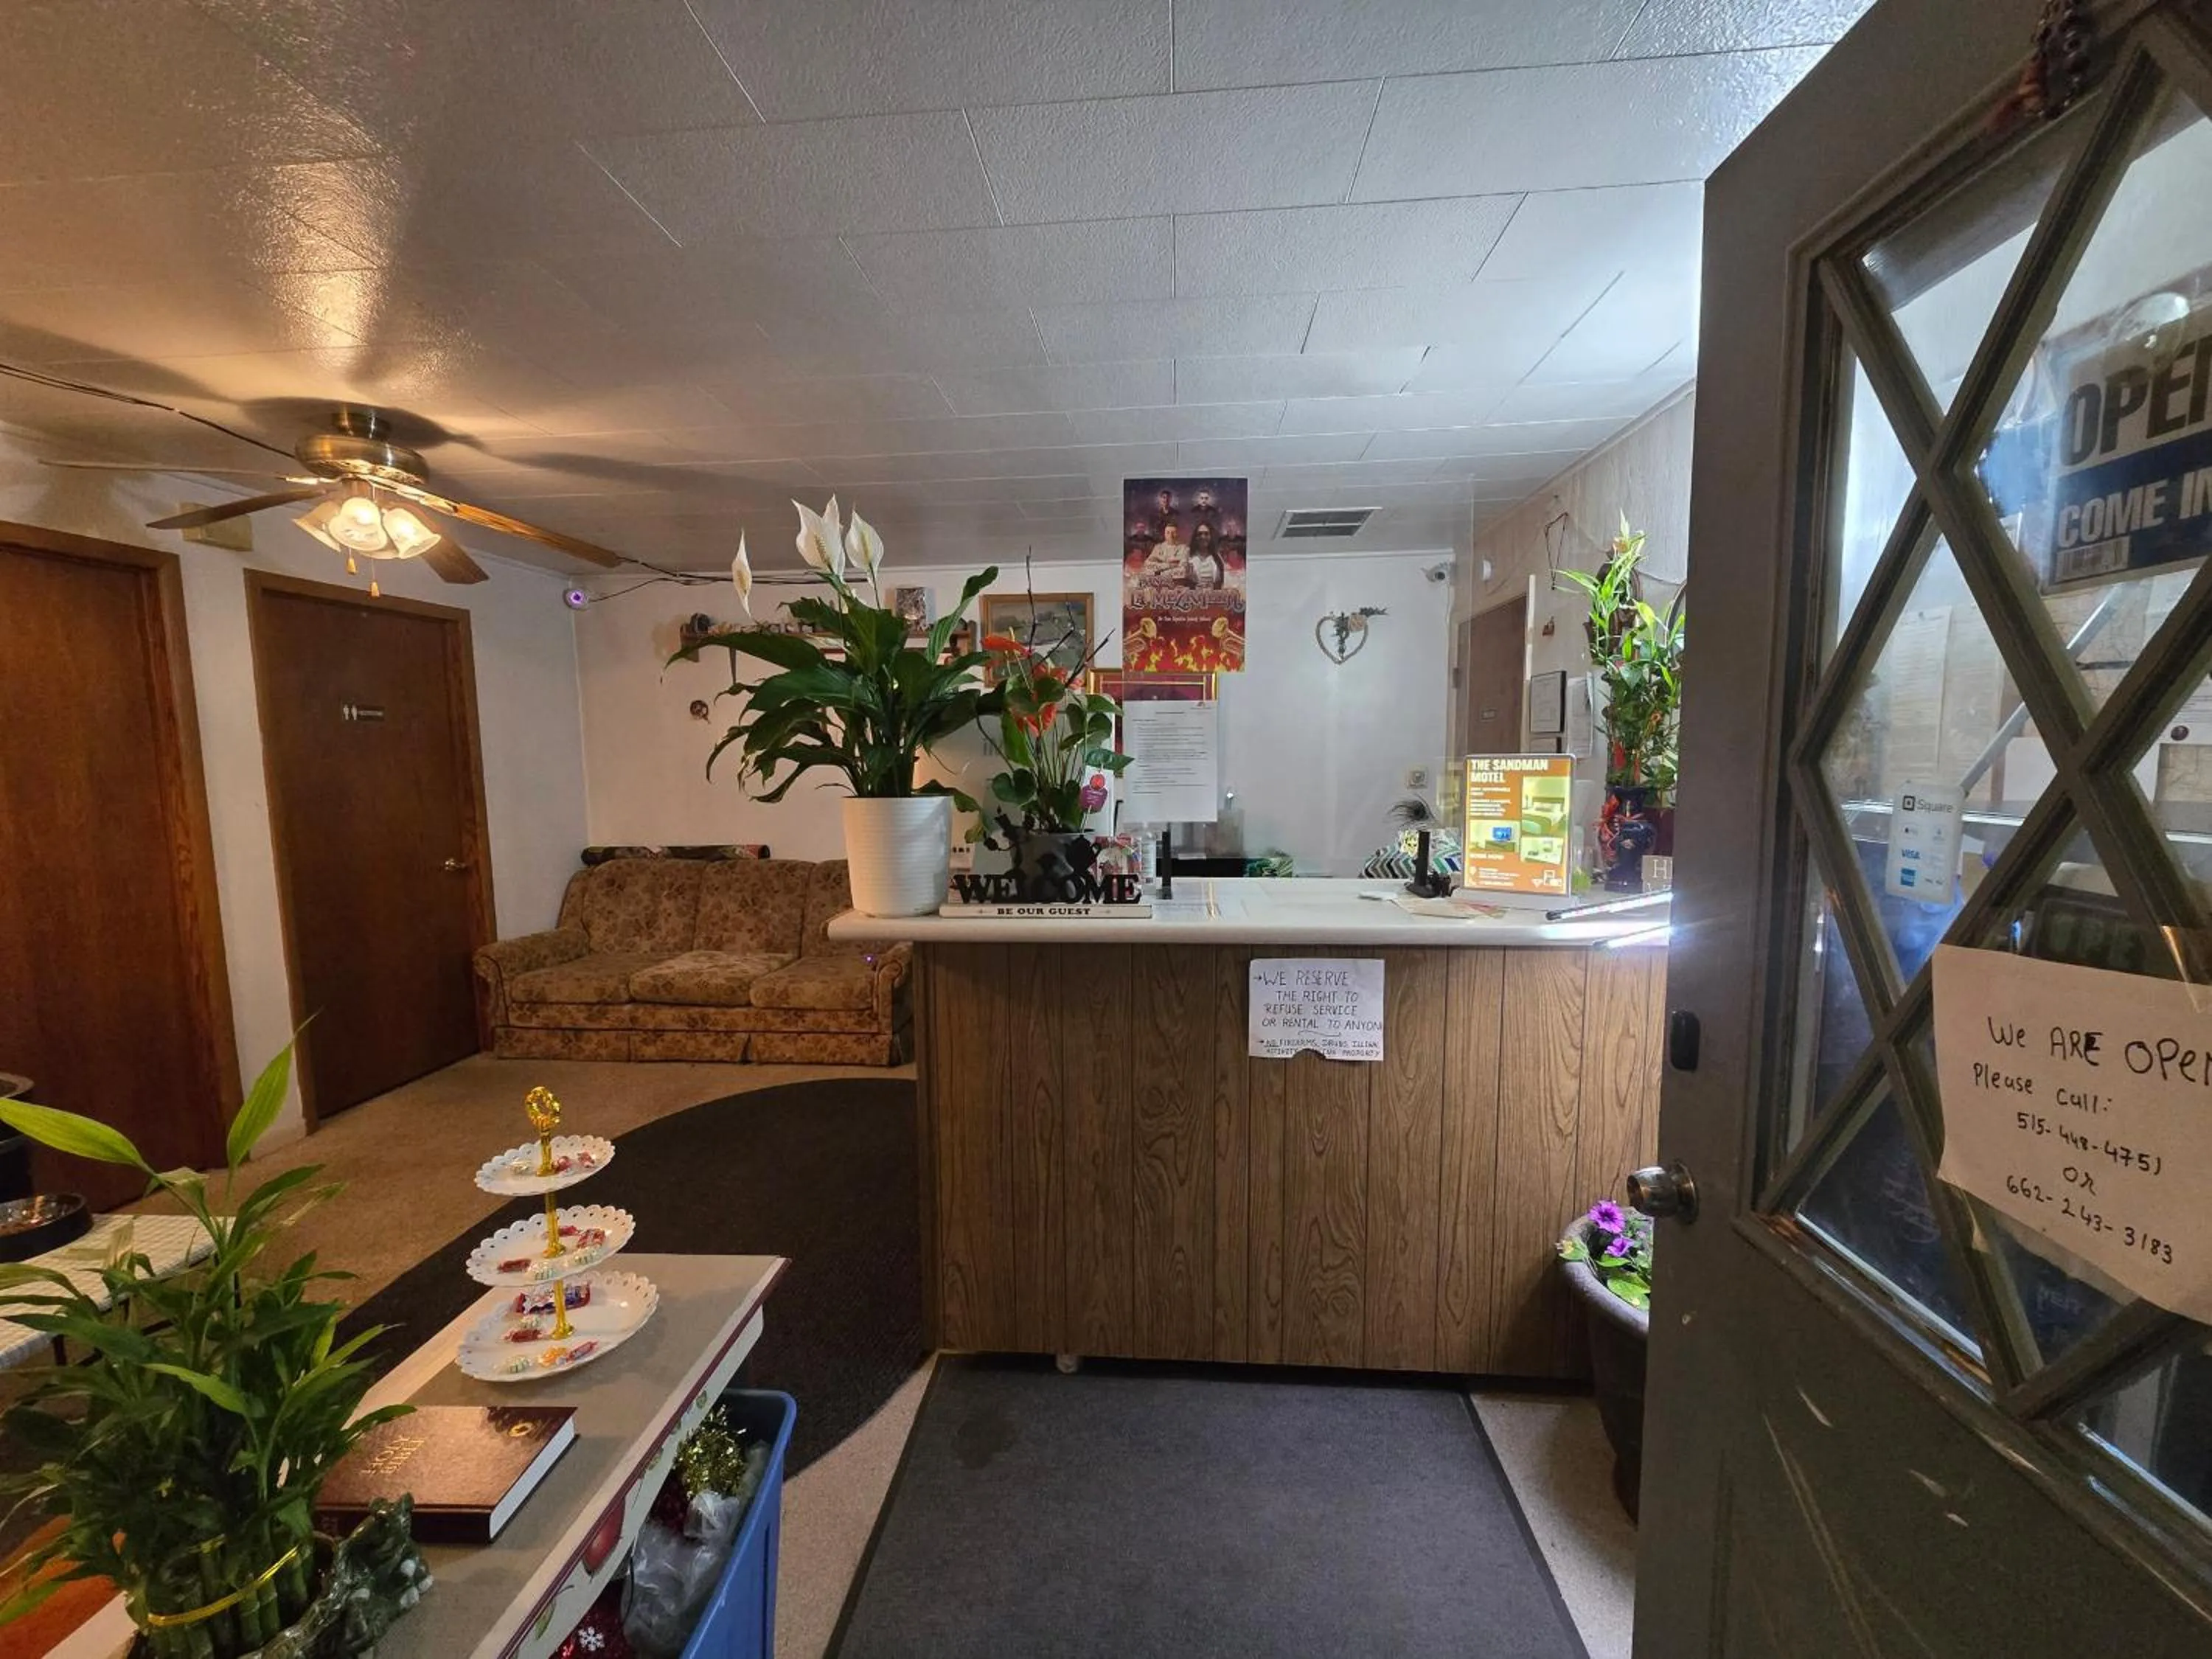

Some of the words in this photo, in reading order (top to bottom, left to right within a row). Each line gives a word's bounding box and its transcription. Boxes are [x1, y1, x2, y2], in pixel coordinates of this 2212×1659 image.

[2057, 479, 2169, 549] COME
[1470, 759, 1490, 771] THE
[1492, 759, 1548, 771] SANDMAN
[1470, 772, 1505, 783] MOTEL
[1917, 799, 1954, 815] Square
[1902, 849, 1921, 860] VISA
[953, 874, 1141, 904] WEOME
[997, 907, 1014, 916] BE
[1017, 907, 1044, 916] OUR
[1048, 907, 1091, 916] GUEST
[1262, 970, 1287, 987] WE
[1295, 970, 1349, 987] RESERVE
[1275, 990, 1298, 1003] THE
[1301, 990, 1338, 1004] RIGHT
[1344, 990, 1359, 1004] TO
[1263, 1003, 1304, 1016] REFUSE
[1312, 1004, 1358, 1016] SERVICE
[1262, 1018, 1277, 1028] OR
[1282, 1018, 1319, 1029] RENTAL
[1327, 1019, 1341, 1030] TO
[1987, 1016, 2026, 1048] We
[2050, 1026, 2104, 1066] ARE
[1973, 1062, 2034, 1095] Please
